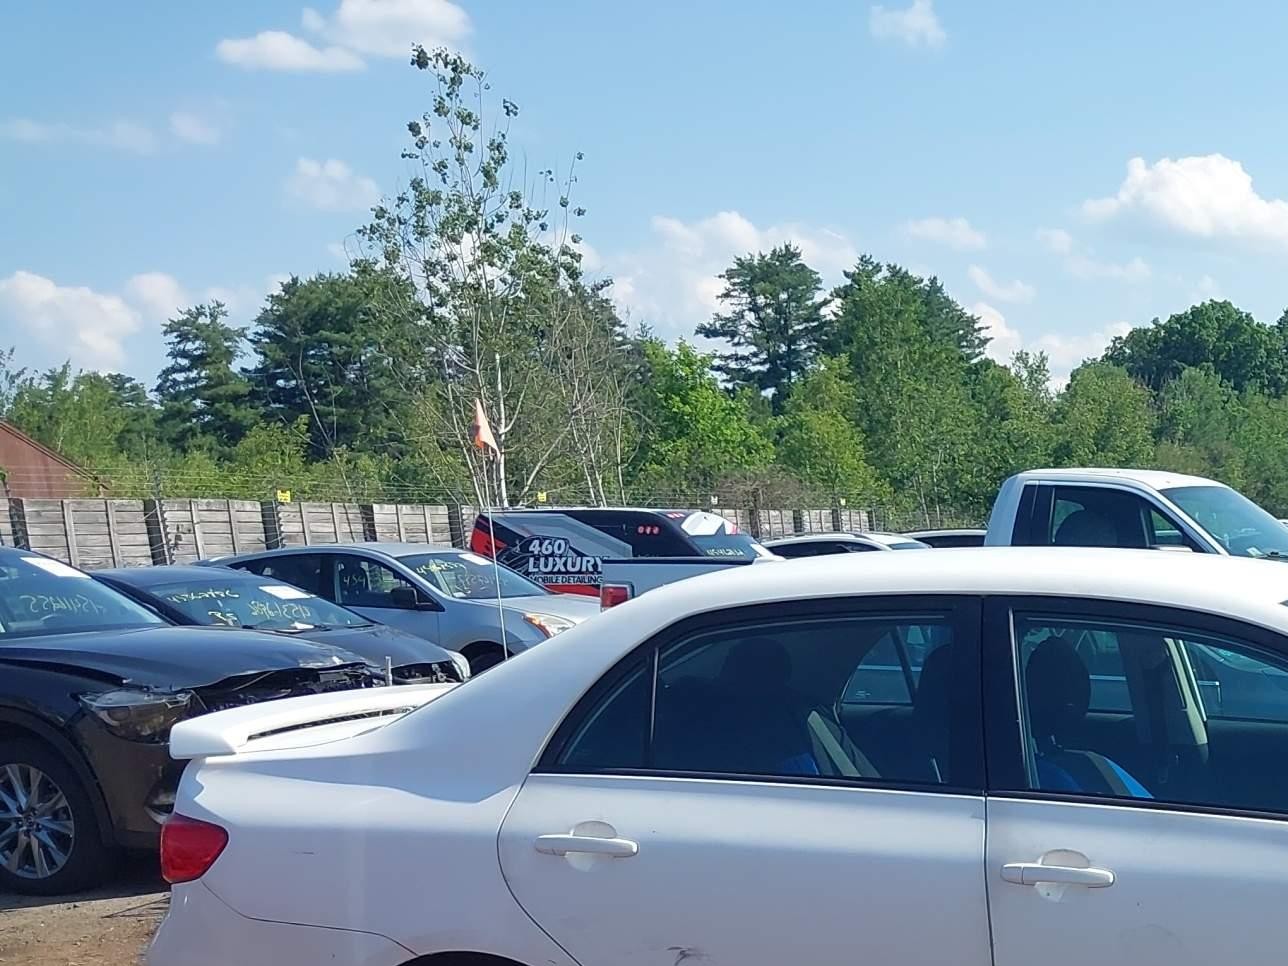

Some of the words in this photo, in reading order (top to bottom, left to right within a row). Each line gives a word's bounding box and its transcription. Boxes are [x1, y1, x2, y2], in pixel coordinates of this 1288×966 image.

[528, 539, 566, 555] 460
[528, 556, 604, 573] LUXURY
[530, 575, 561, 584] MOBILE
[561, 575, 604, 584] DETAILING
